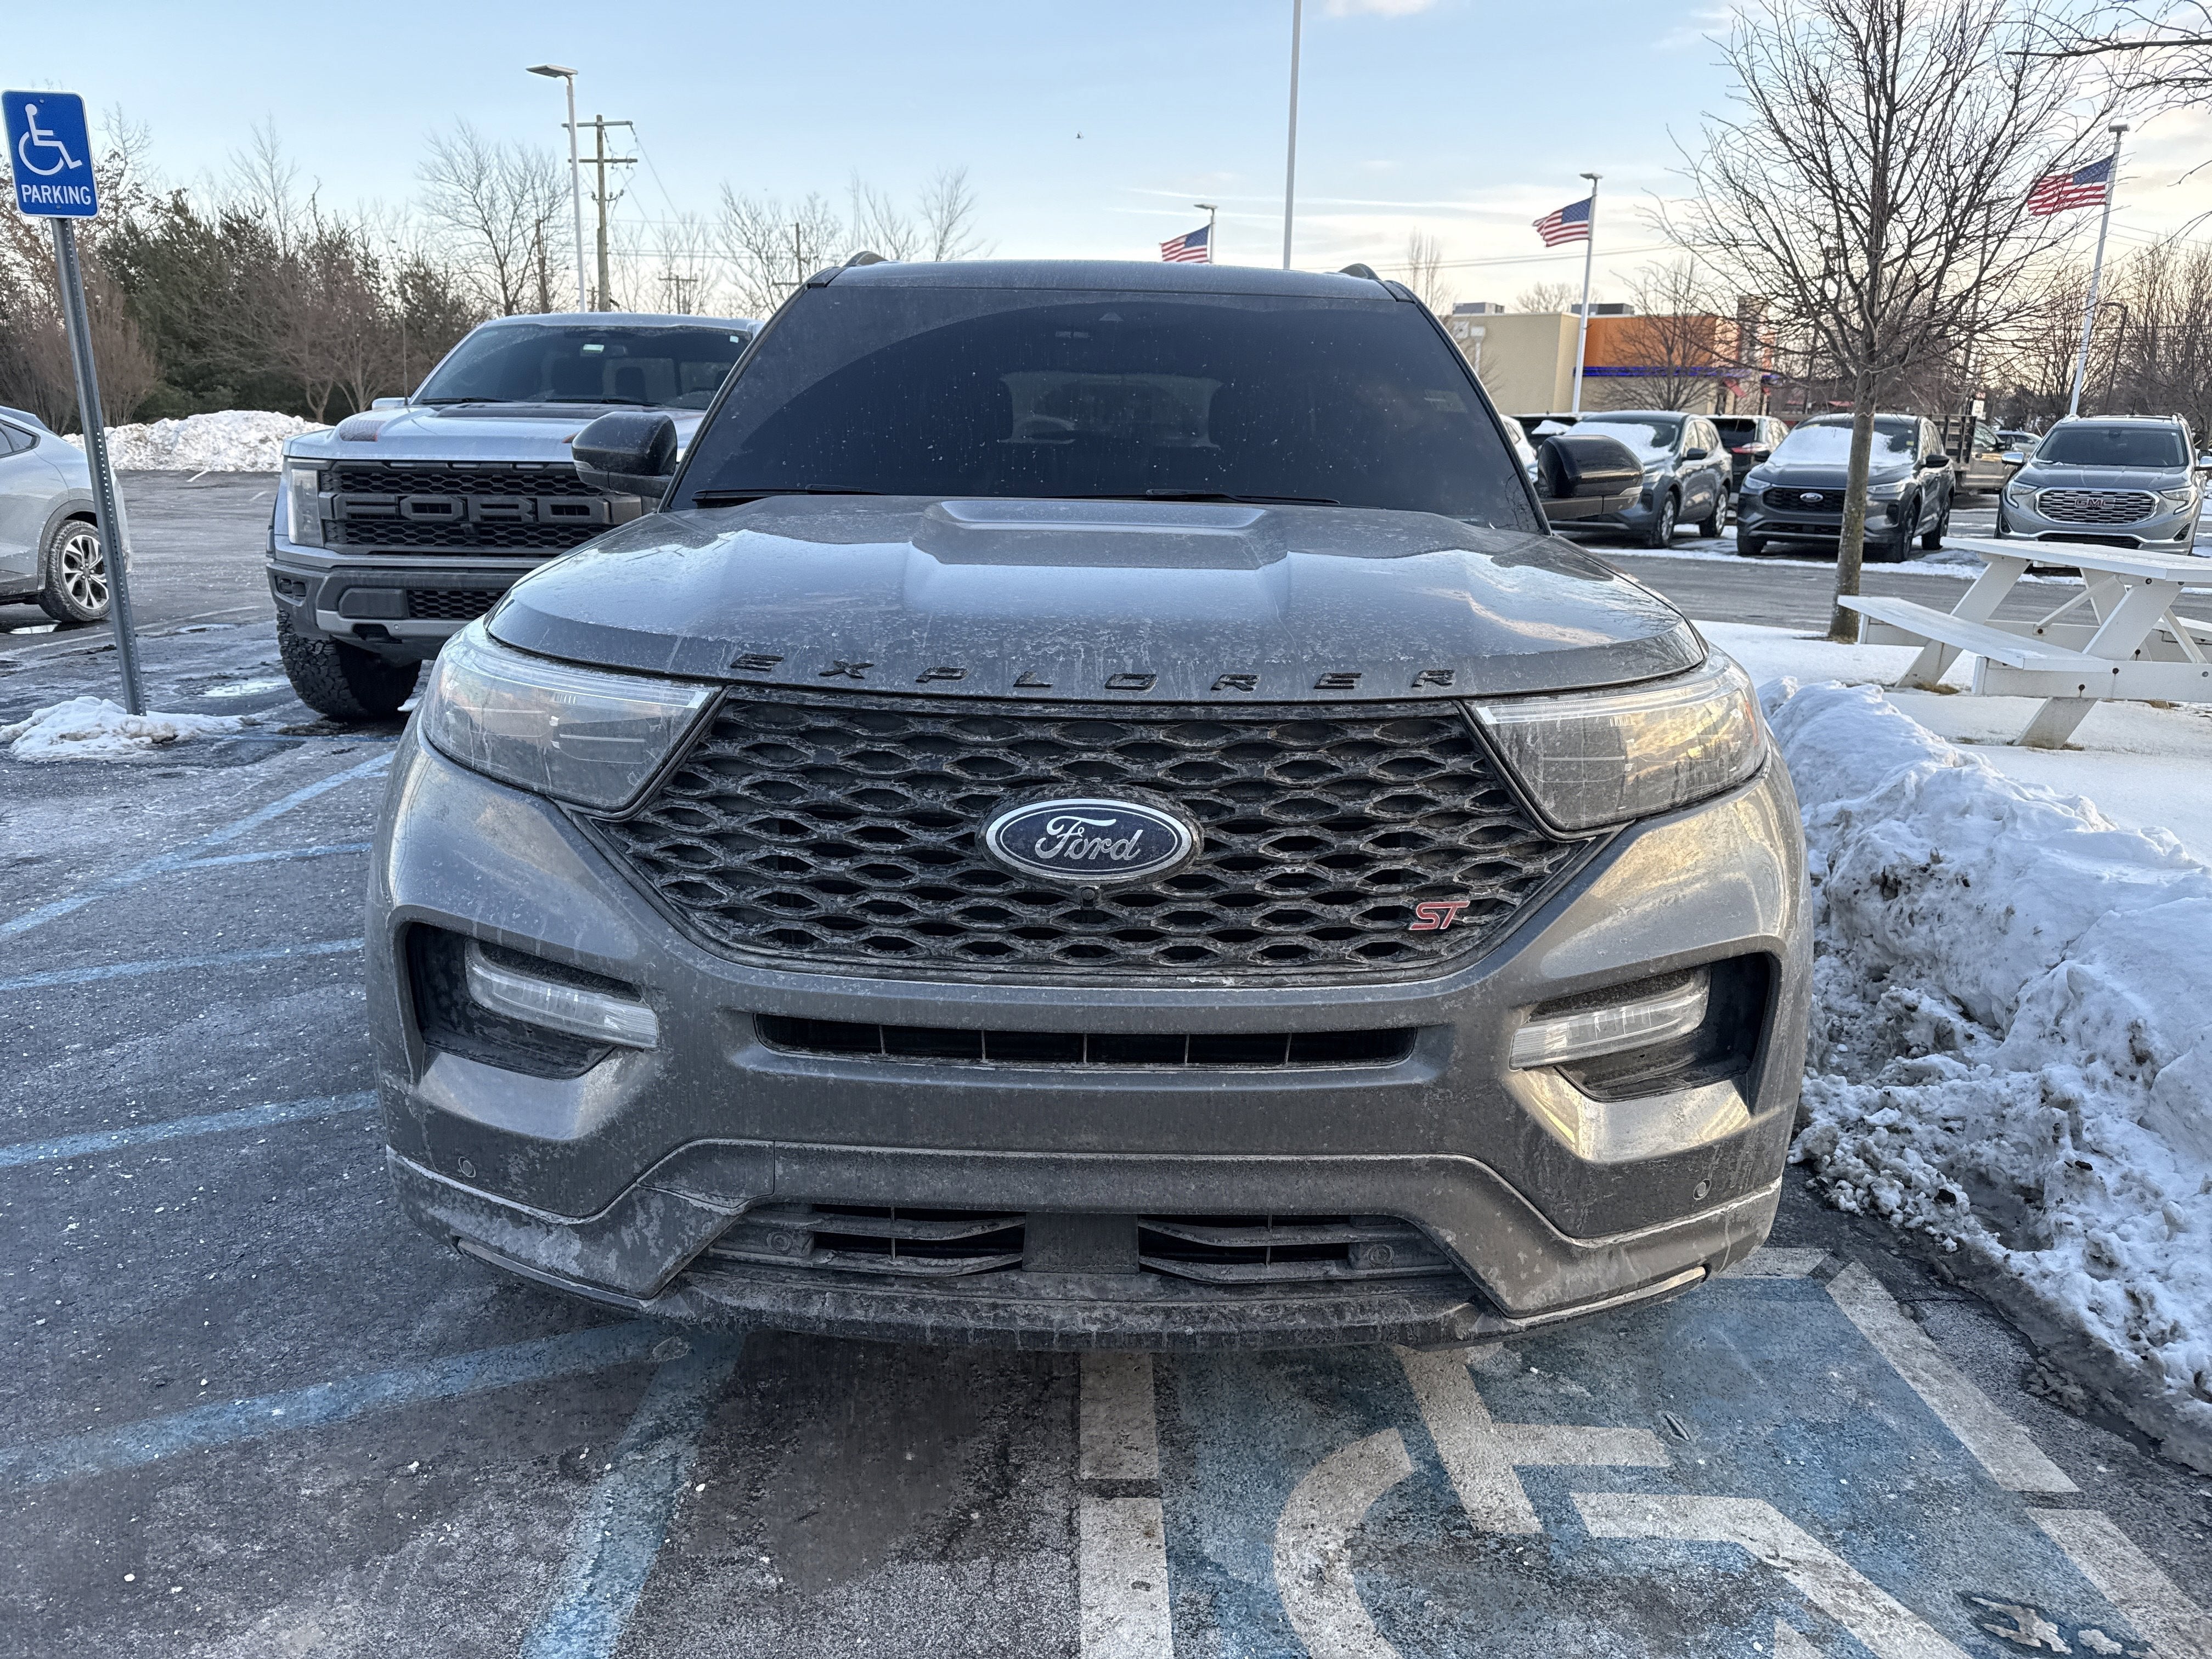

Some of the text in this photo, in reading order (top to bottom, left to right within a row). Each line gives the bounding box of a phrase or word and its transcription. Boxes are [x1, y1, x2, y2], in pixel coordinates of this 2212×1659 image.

[21, 184, 92, 206] PARKING
[333, 495, 608, 524] FORD
[2074, 497, 2117, 509] GMC
[730, 653, 1455, 692] EXPLORER
[1034, 815, 1143, 861] Ford
[1408, 900, 1471, 930] ST
